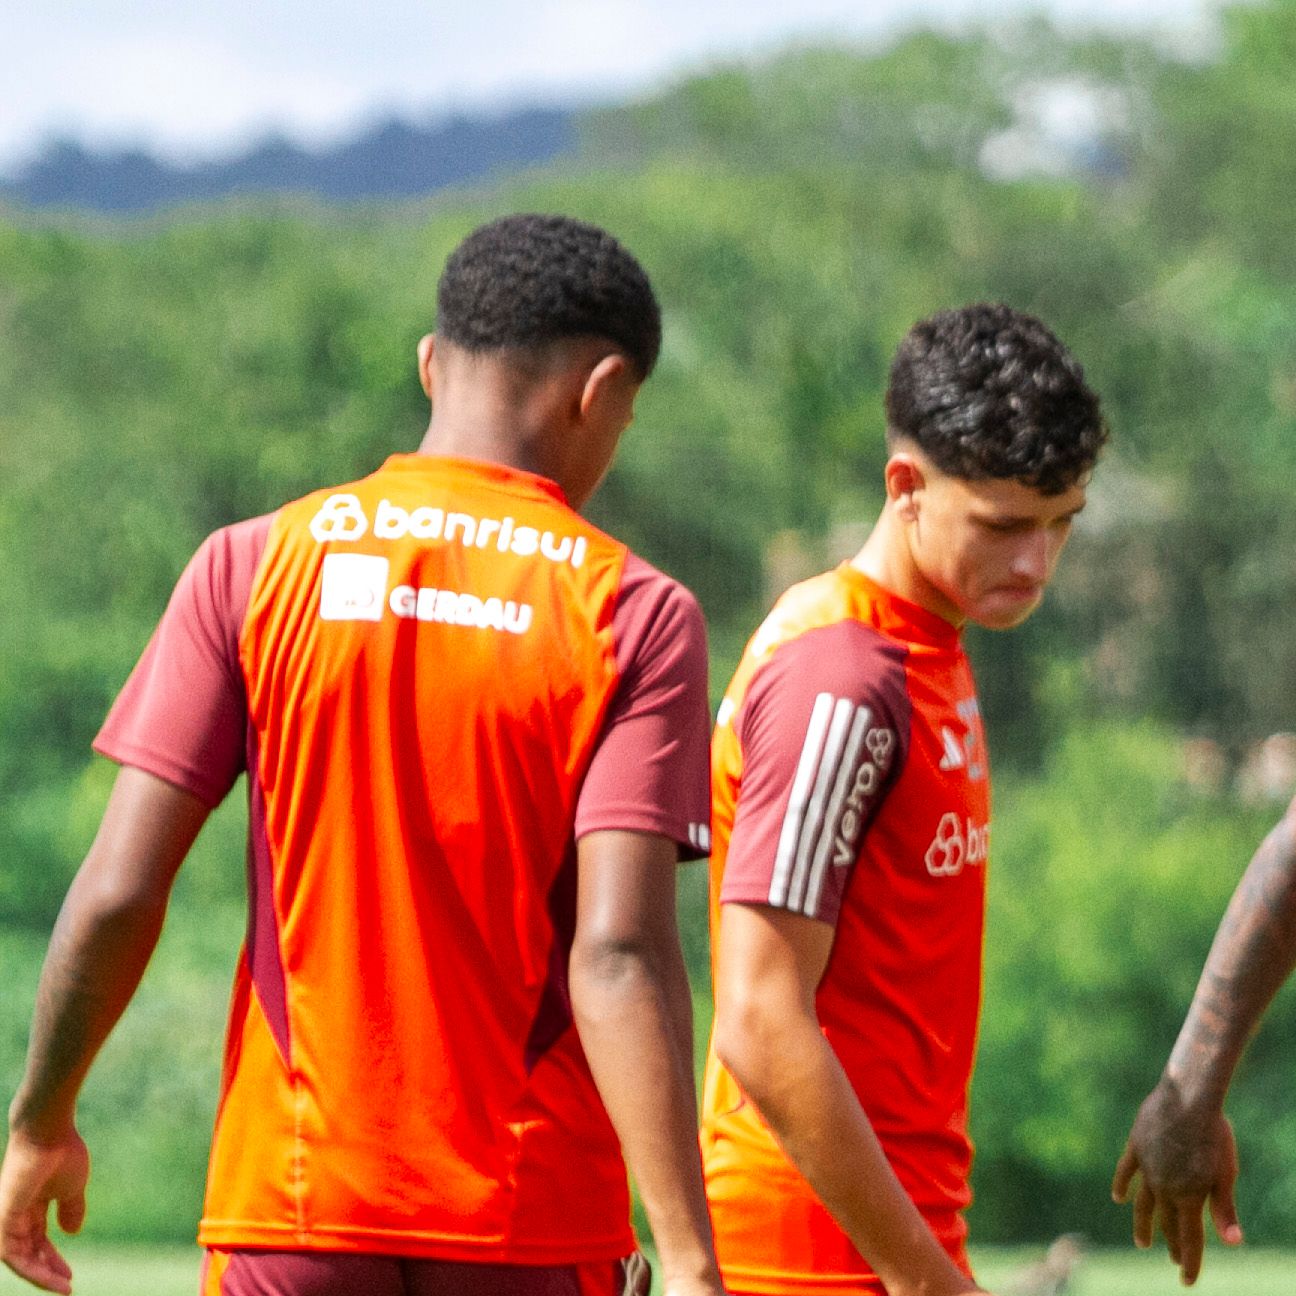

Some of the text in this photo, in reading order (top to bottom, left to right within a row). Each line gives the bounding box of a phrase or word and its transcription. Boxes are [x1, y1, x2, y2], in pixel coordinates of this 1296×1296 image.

[373, 498, 587, 568] banrisul
[389, 585, 533, 634] GERDAU
[833, 762, 876, 866] vero
